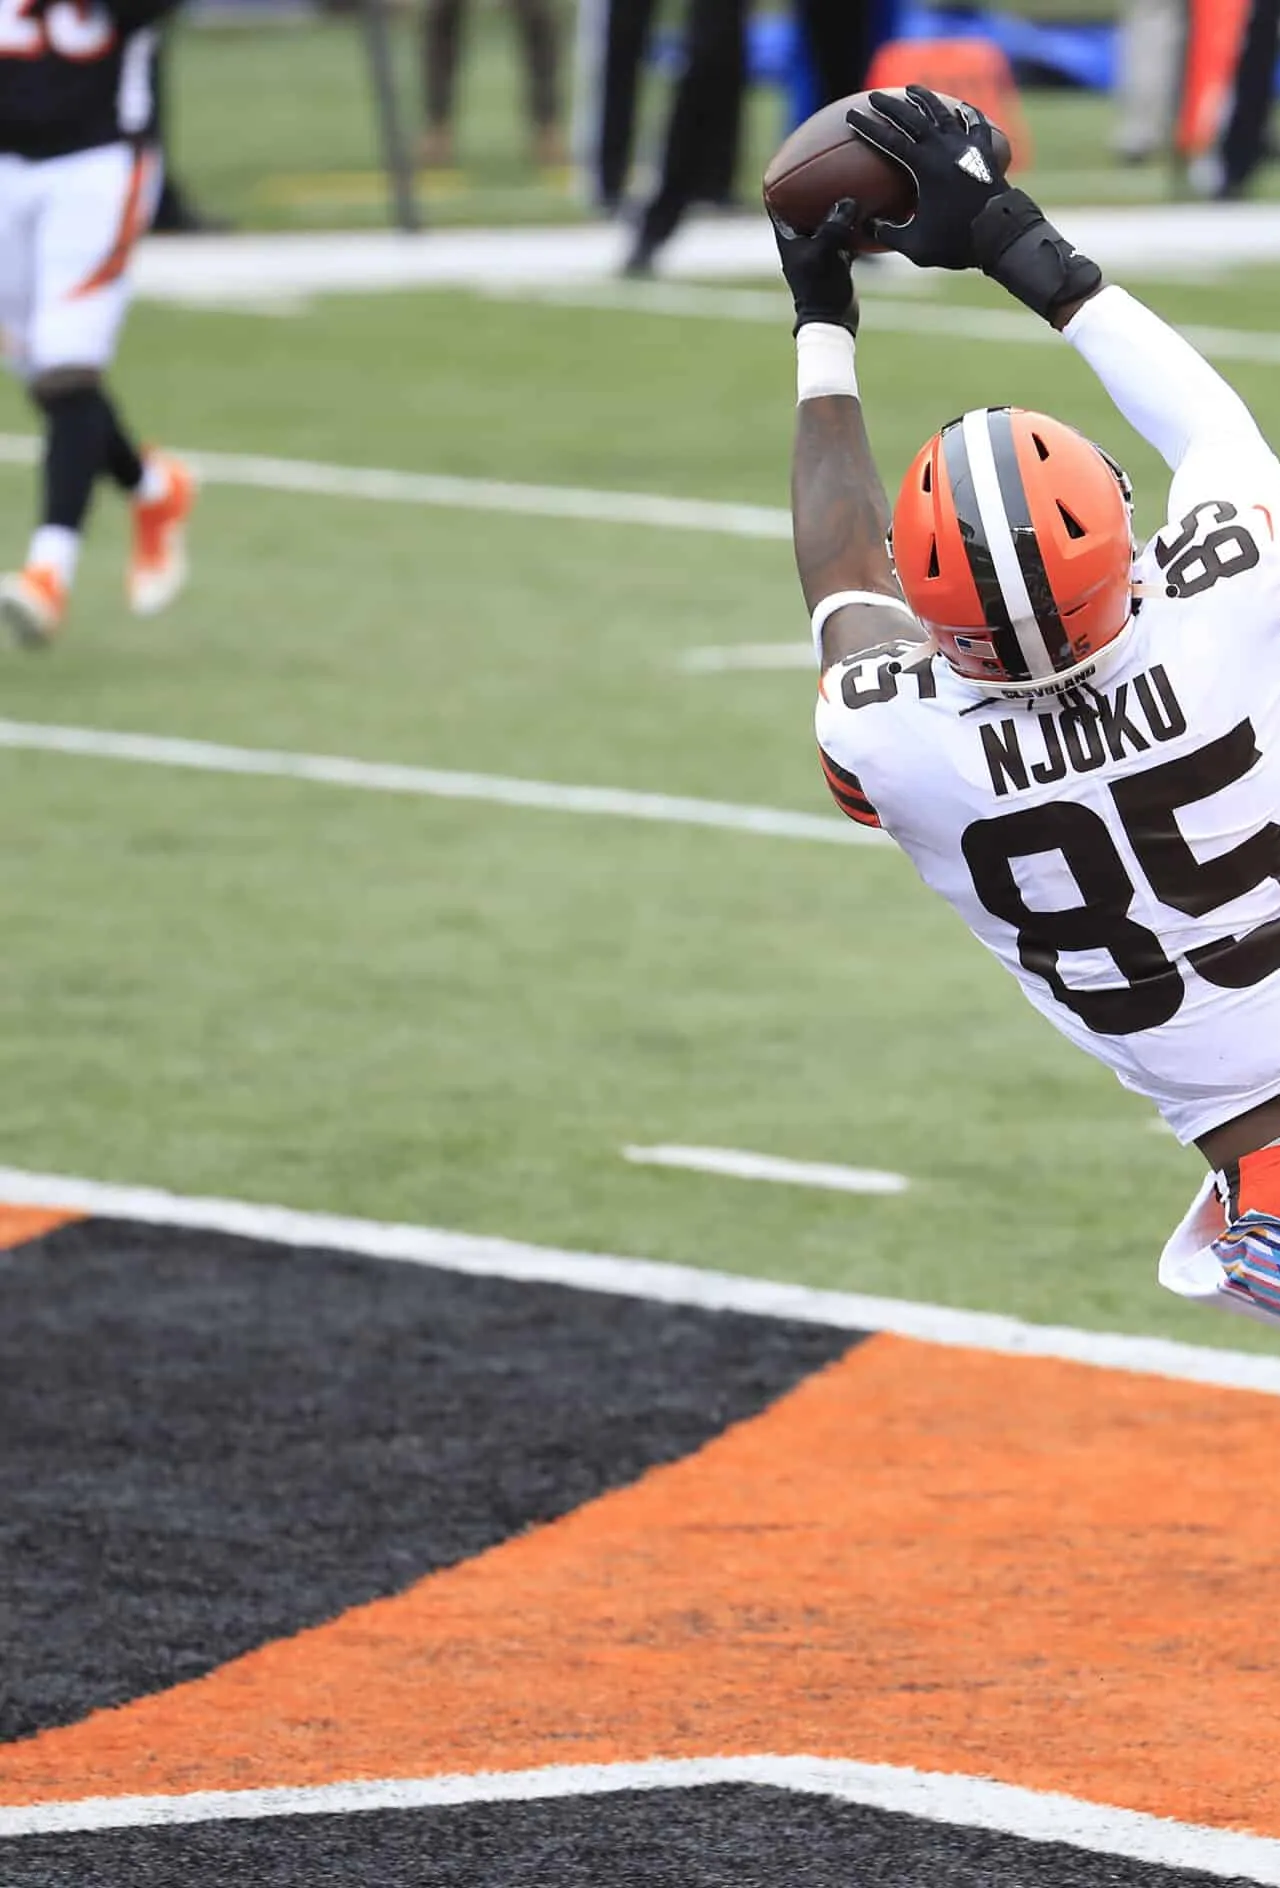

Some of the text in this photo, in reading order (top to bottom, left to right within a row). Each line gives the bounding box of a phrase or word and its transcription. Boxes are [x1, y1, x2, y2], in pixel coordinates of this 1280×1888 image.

[1155, 500, 1260, 598] 85
[978, 664, 1188, 796] NJOKU
[1001, 664, 1096, 699] CLEVELAND
